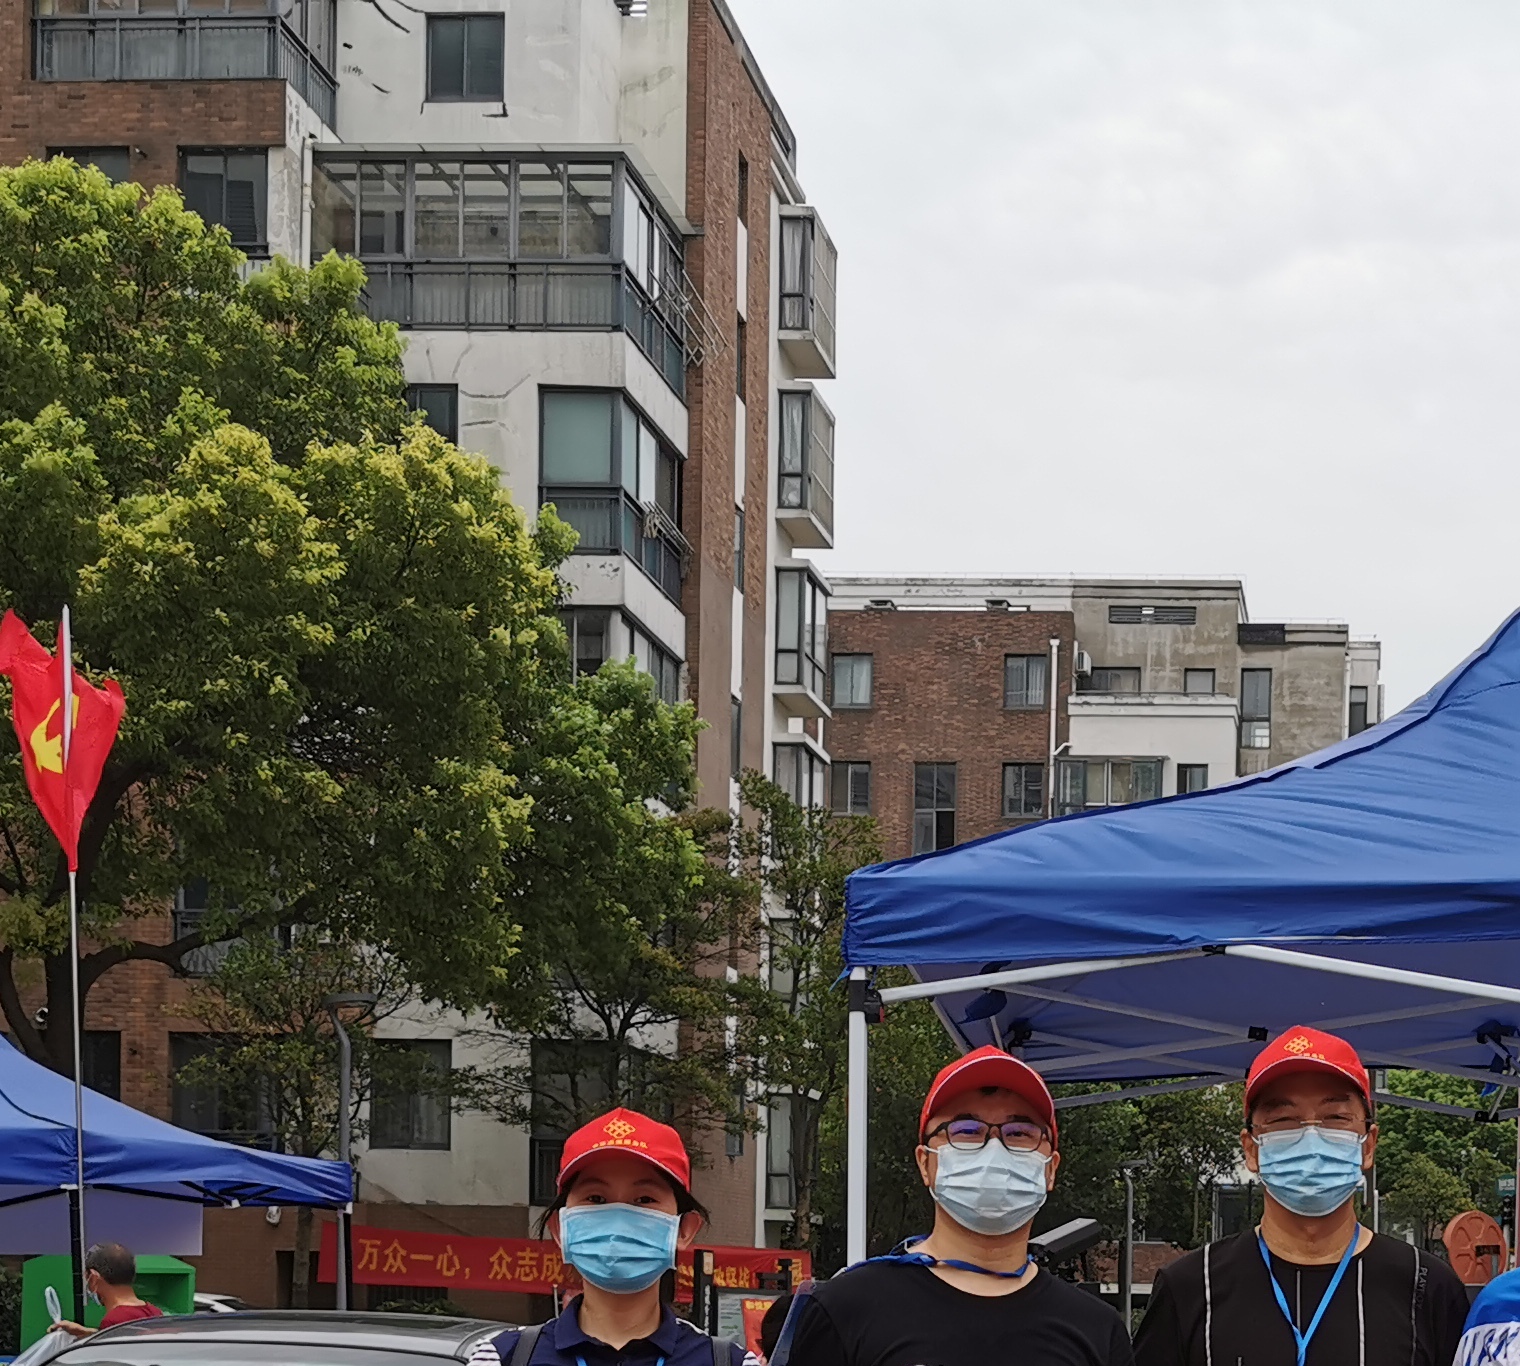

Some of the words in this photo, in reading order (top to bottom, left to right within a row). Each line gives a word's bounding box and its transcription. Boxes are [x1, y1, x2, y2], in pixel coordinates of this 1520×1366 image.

[357, 1238, 578, 1283] 万众一心，众志成
